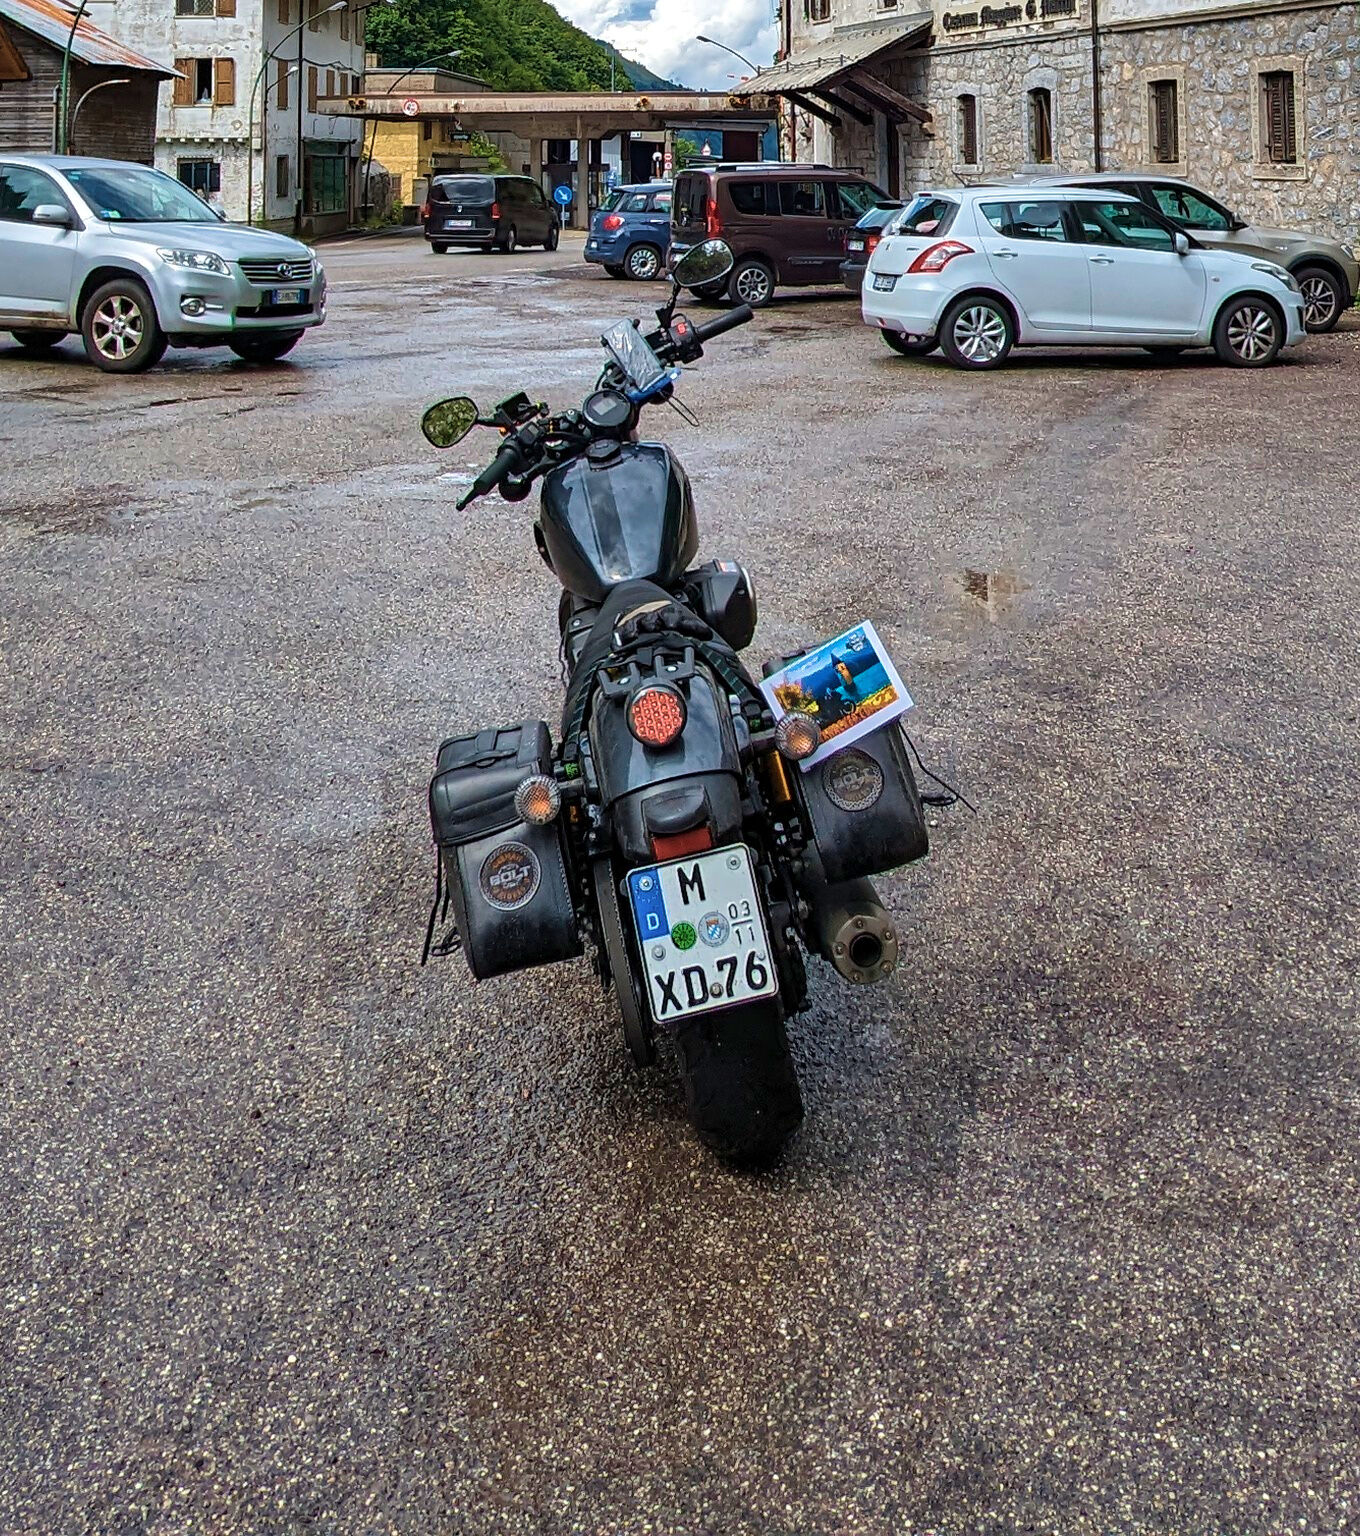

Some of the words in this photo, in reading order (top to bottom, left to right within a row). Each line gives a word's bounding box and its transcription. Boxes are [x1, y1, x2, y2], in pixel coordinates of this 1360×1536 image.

[676, 862, 707, 905] M
[727, 900, 751, 920] 03
[646, 912, 660, 931] D
